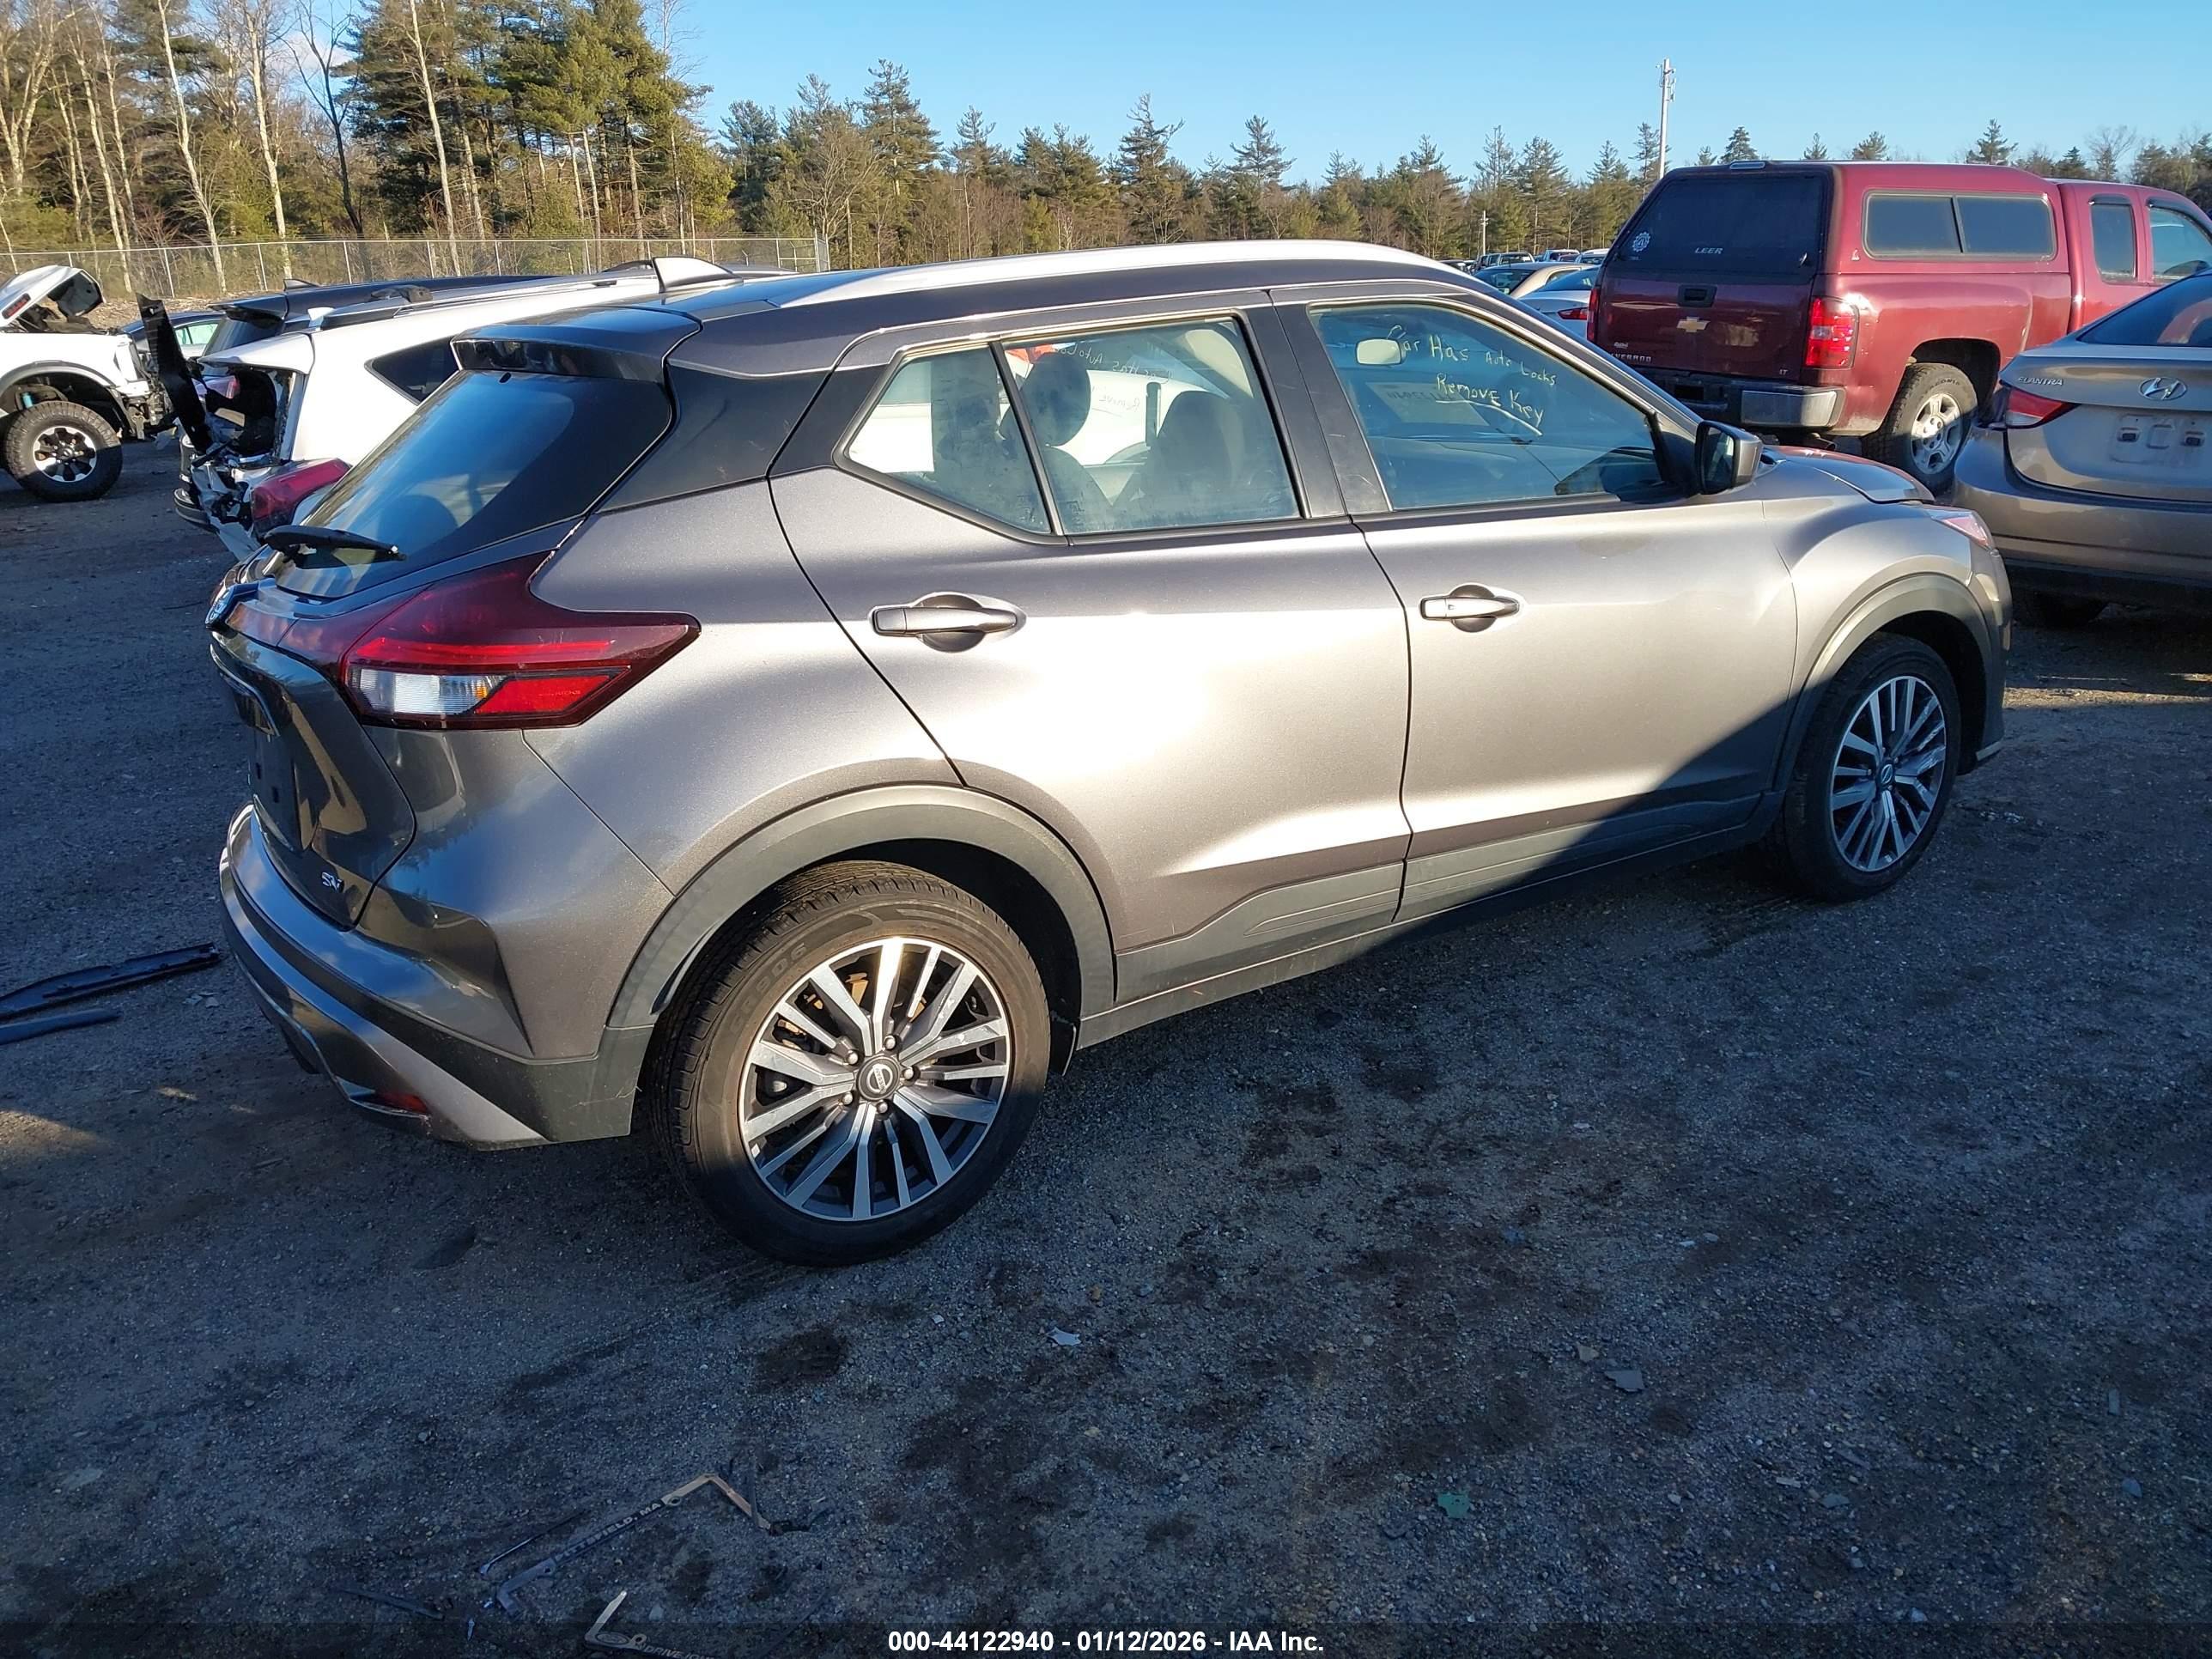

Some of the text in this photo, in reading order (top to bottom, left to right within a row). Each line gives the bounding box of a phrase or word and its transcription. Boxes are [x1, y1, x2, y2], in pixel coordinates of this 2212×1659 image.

[1694, 246, 1724, 255] LEER
[1429, 333, 1470, 362] Has
[1485, 349, 1512, 367] Auto
[1521, 361, 1558, 386] Locks
[2018, 376, 2064, 386] ELANTRA
[639, 1502, 662, 1516] MA
